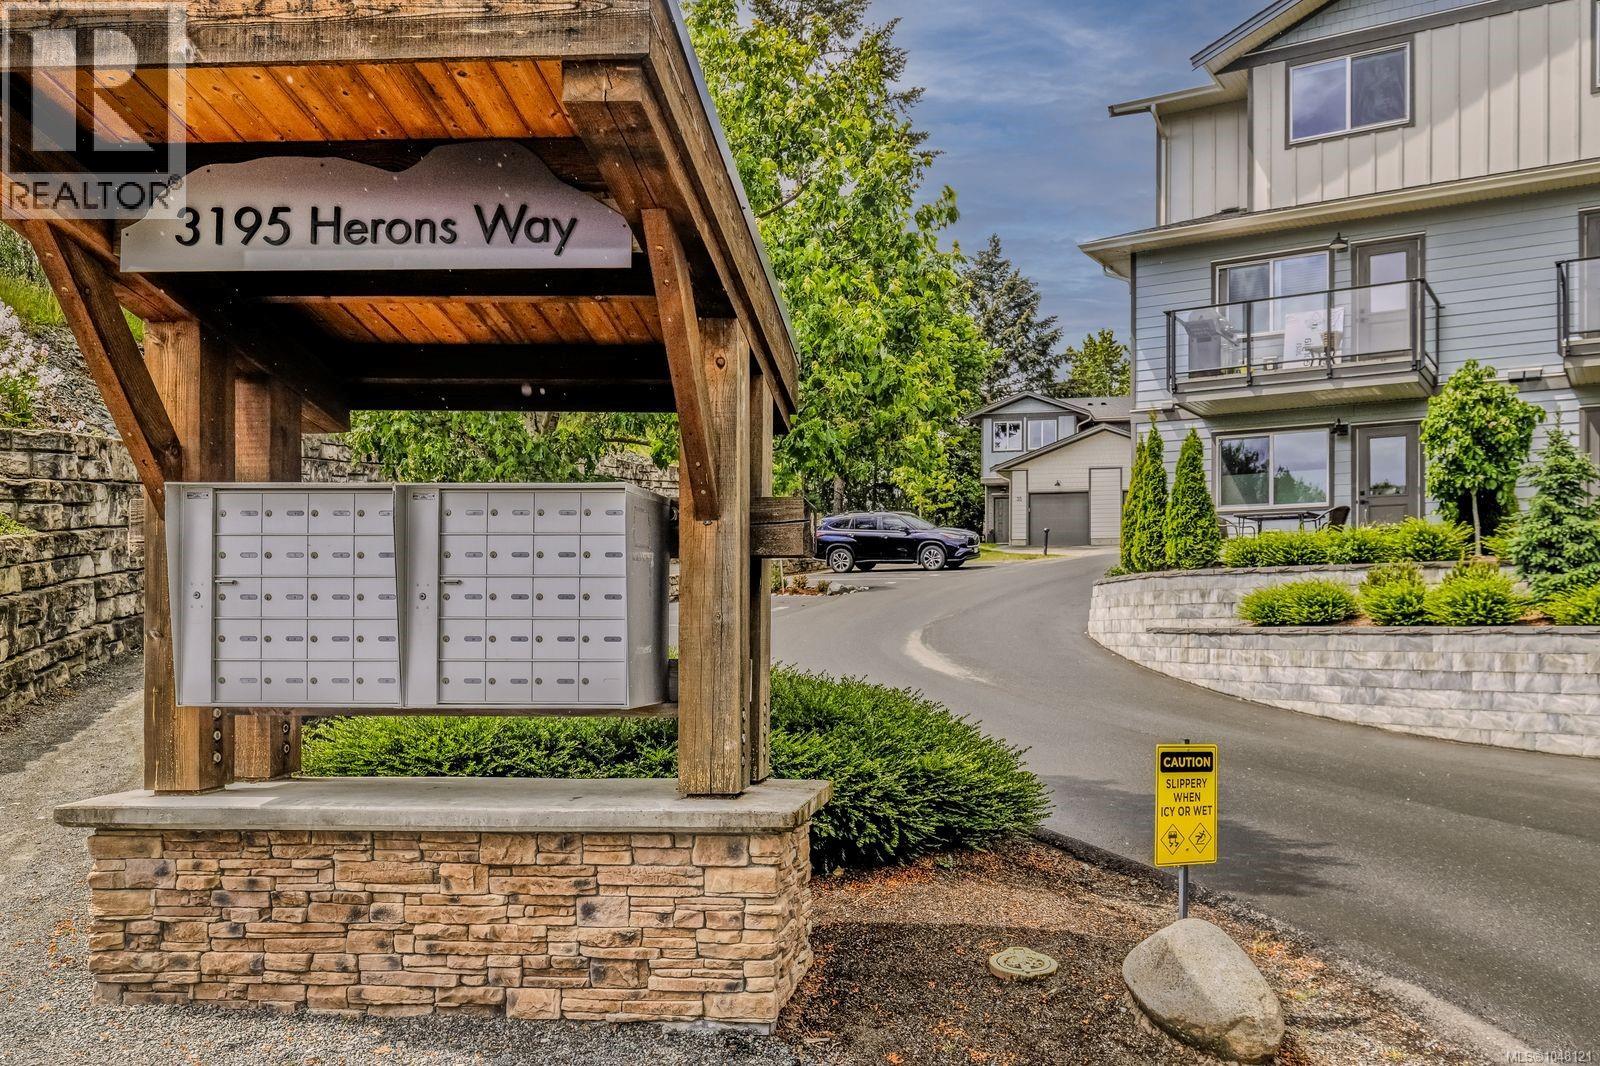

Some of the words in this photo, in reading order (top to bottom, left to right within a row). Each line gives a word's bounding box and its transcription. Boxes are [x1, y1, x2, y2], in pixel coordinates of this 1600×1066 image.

[175, 206, 291, 246] 3195
[310, 205, 457, 246] Herons
[473, 203, 578, 256] Way
[1163, 757, 1211, 768] CAUTION
[1166, 778, 1208, 789] SLIPPERY
[1173, 792, 1201, 802] WHEN
[1161, 806, 1175, 817] ICY
[1178, 806, 1191, 816] OR
[1193, 805, 1213, 816] WET
